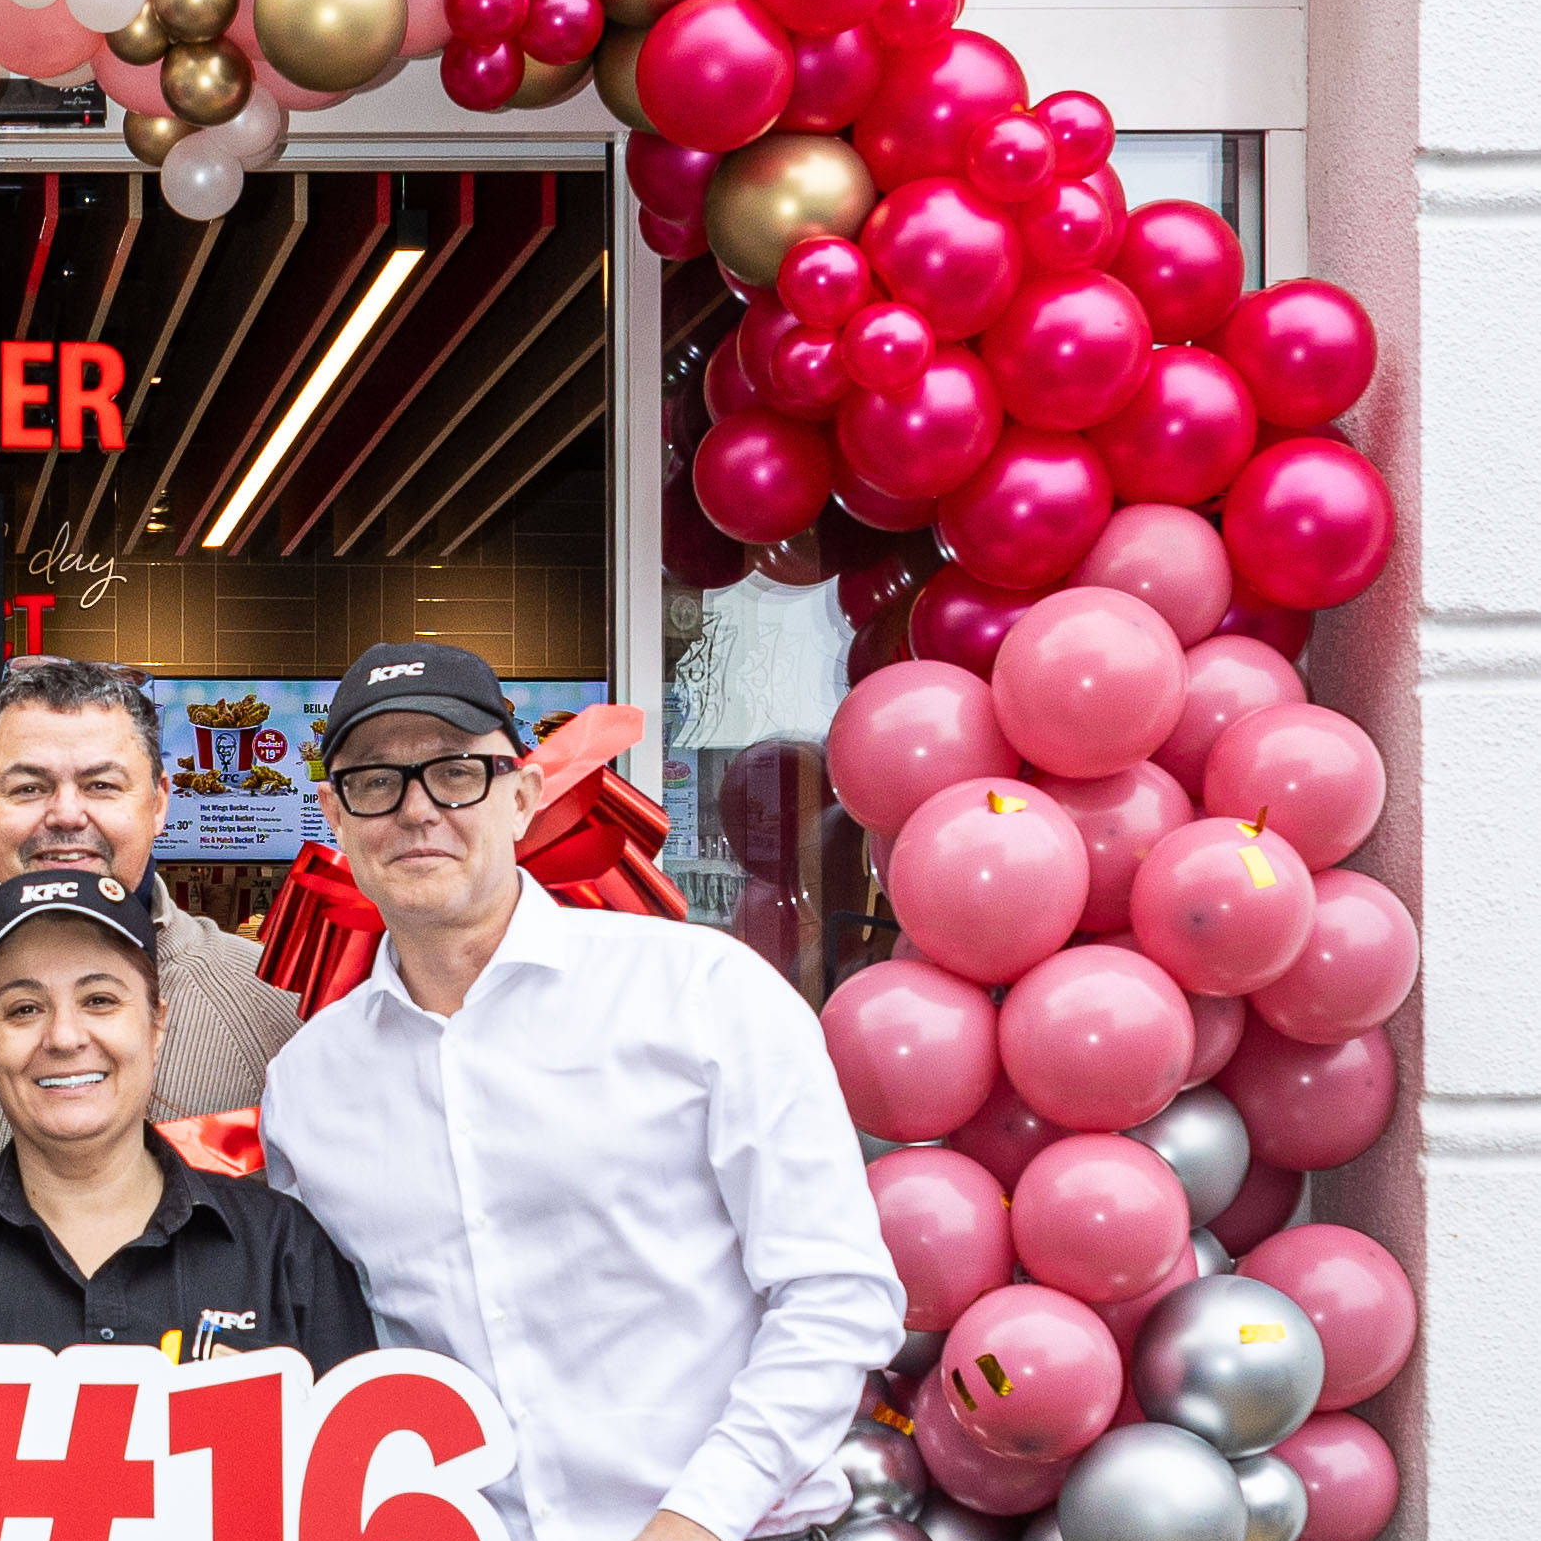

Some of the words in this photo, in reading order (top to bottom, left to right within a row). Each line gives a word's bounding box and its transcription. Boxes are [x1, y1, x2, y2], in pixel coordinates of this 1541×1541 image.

[28, 520, 127, 609] day
[367, 662, 425, 686] KFC
[304, 703, 330, 714] BEILA
[303, 794, 319, 804] DIP
[20, 882, 79, 904] KFC
